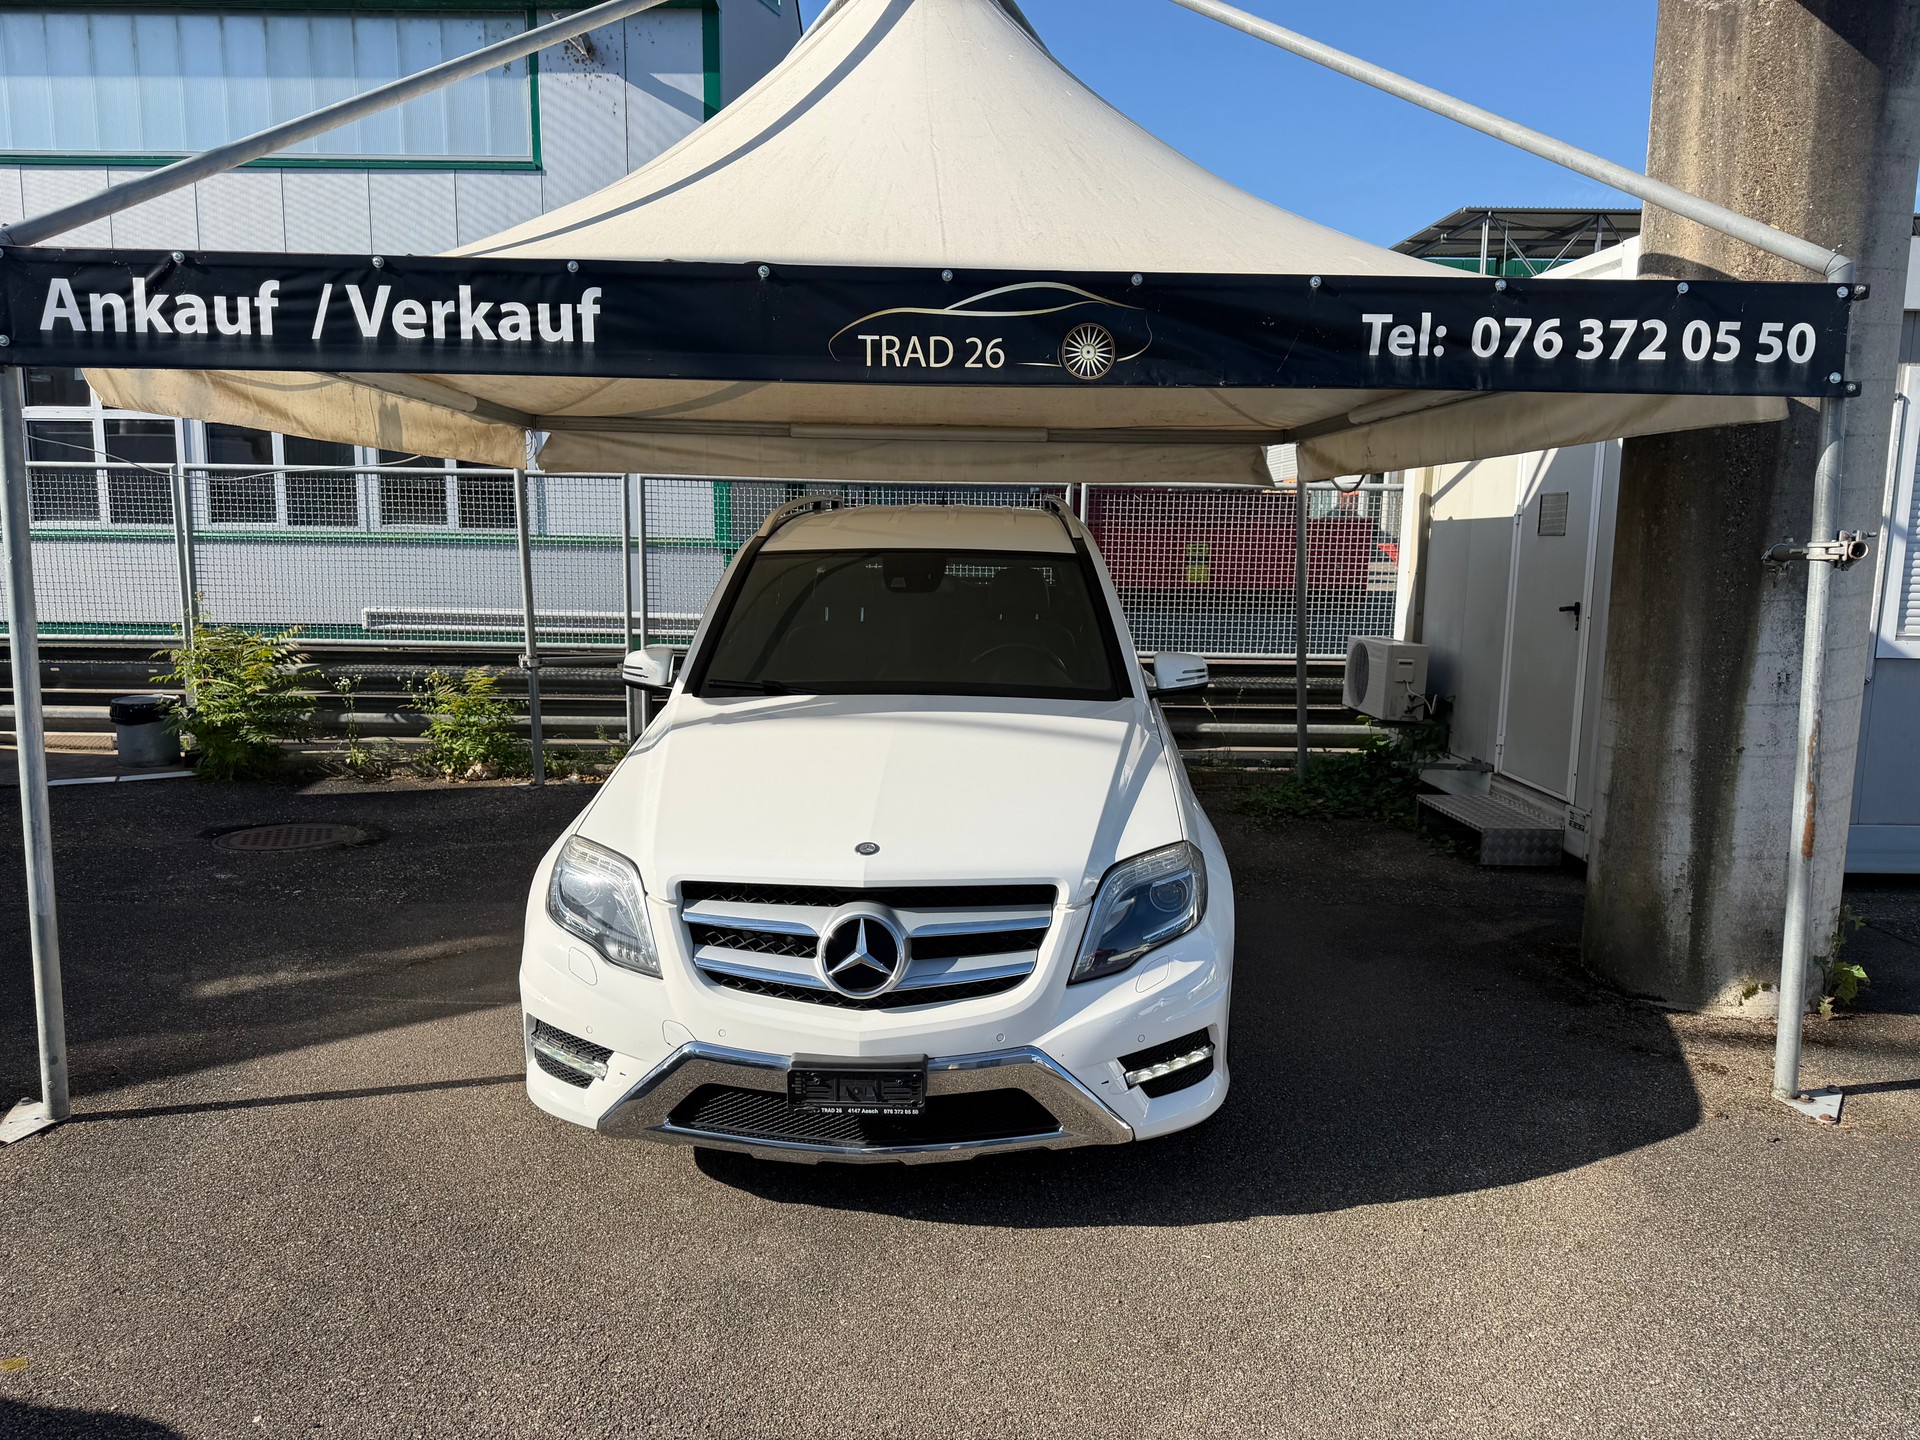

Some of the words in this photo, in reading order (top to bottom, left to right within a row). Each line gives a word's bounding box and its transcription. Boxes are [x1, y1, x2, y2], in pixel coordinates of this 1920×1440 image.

[39, 277, 280, 336] Ankauf
[857, 334, 954, 368] TRAD
[964, 336, 1005, 369] 26
[1361, 311, 1447, 358] Tel:
[1471, 316, 1564, 360] 076
[1575, 318, 1668, 361] 372
[1681, 319, 1742, 363] 05
[1754, 322, 1816, 364] 50
